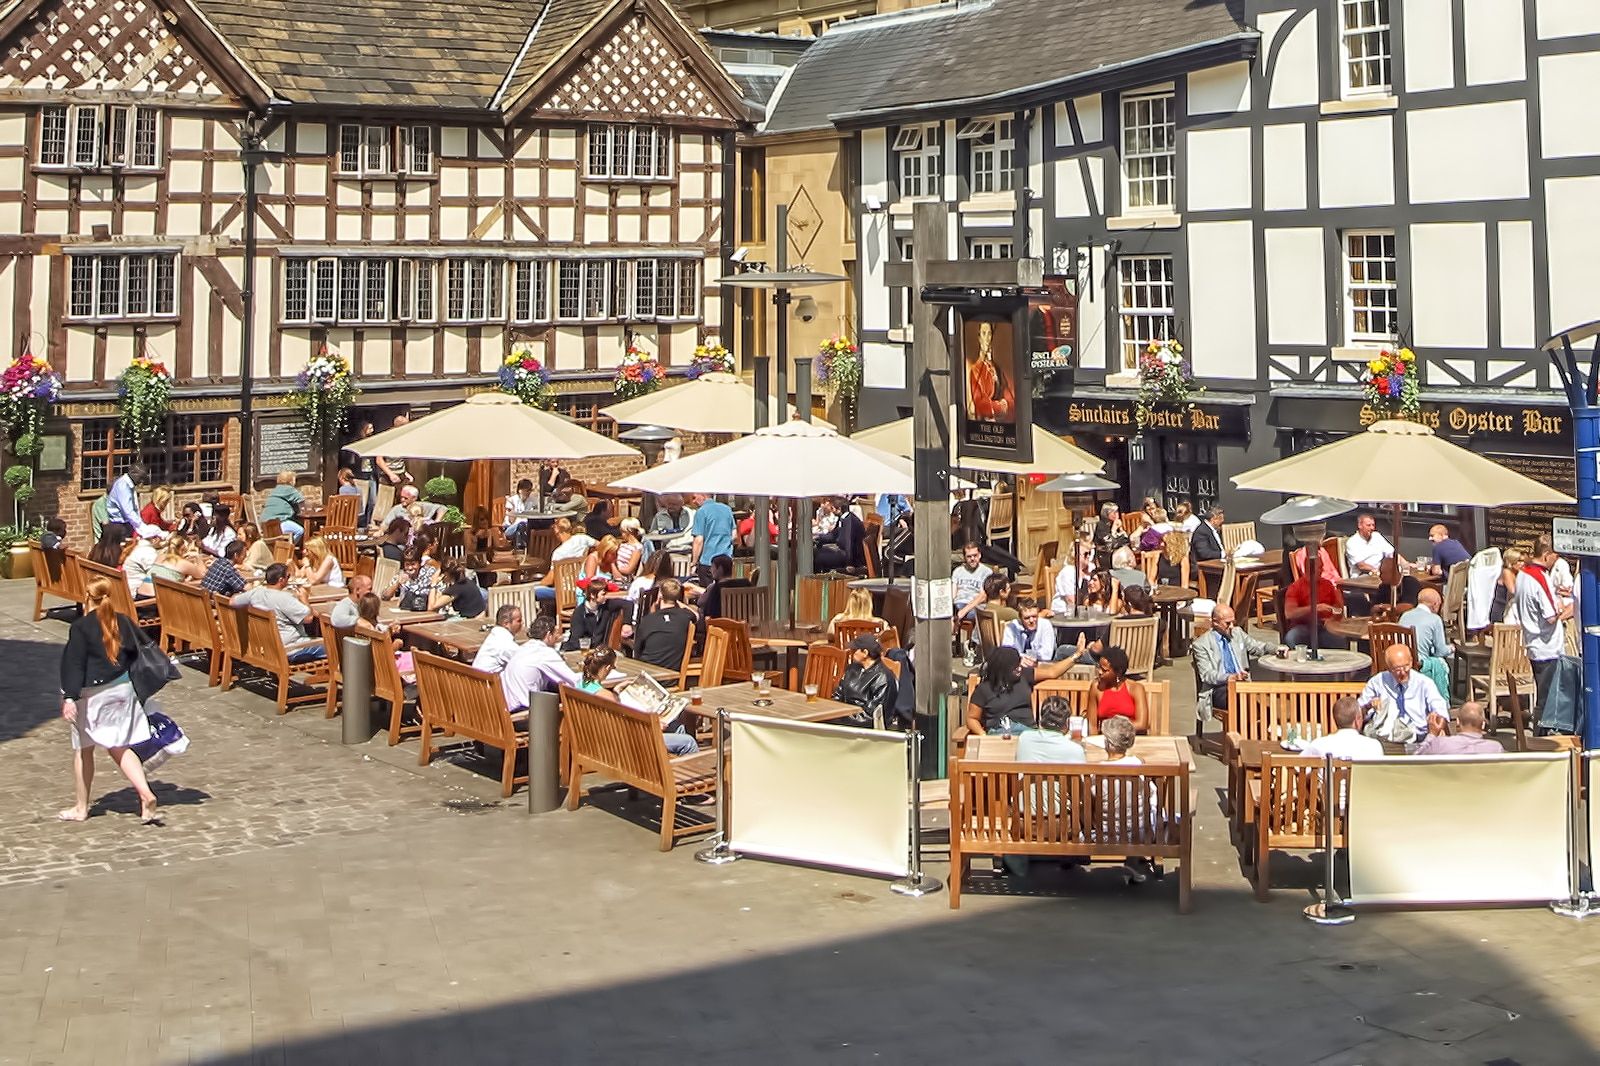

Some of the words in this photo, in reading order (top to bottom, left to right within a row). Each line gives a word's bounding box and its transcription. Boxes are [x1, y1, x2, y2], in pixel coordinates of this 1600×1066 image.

[52, 403, 79, 416] THE
[85, 402, 116, 415] OLD
[1068, 402, 1130, 425] Sinclairs
[1135, 404, 1184, 429] Oyster
[1190, 407, 1220, 431] Bar
[1449, 406, 1514, 434] Oyster
[1521, 408, 1563, 436] Bar
[1576, 521, 1587, 529] No
[1557, 528, 1600, 537] skateboard
